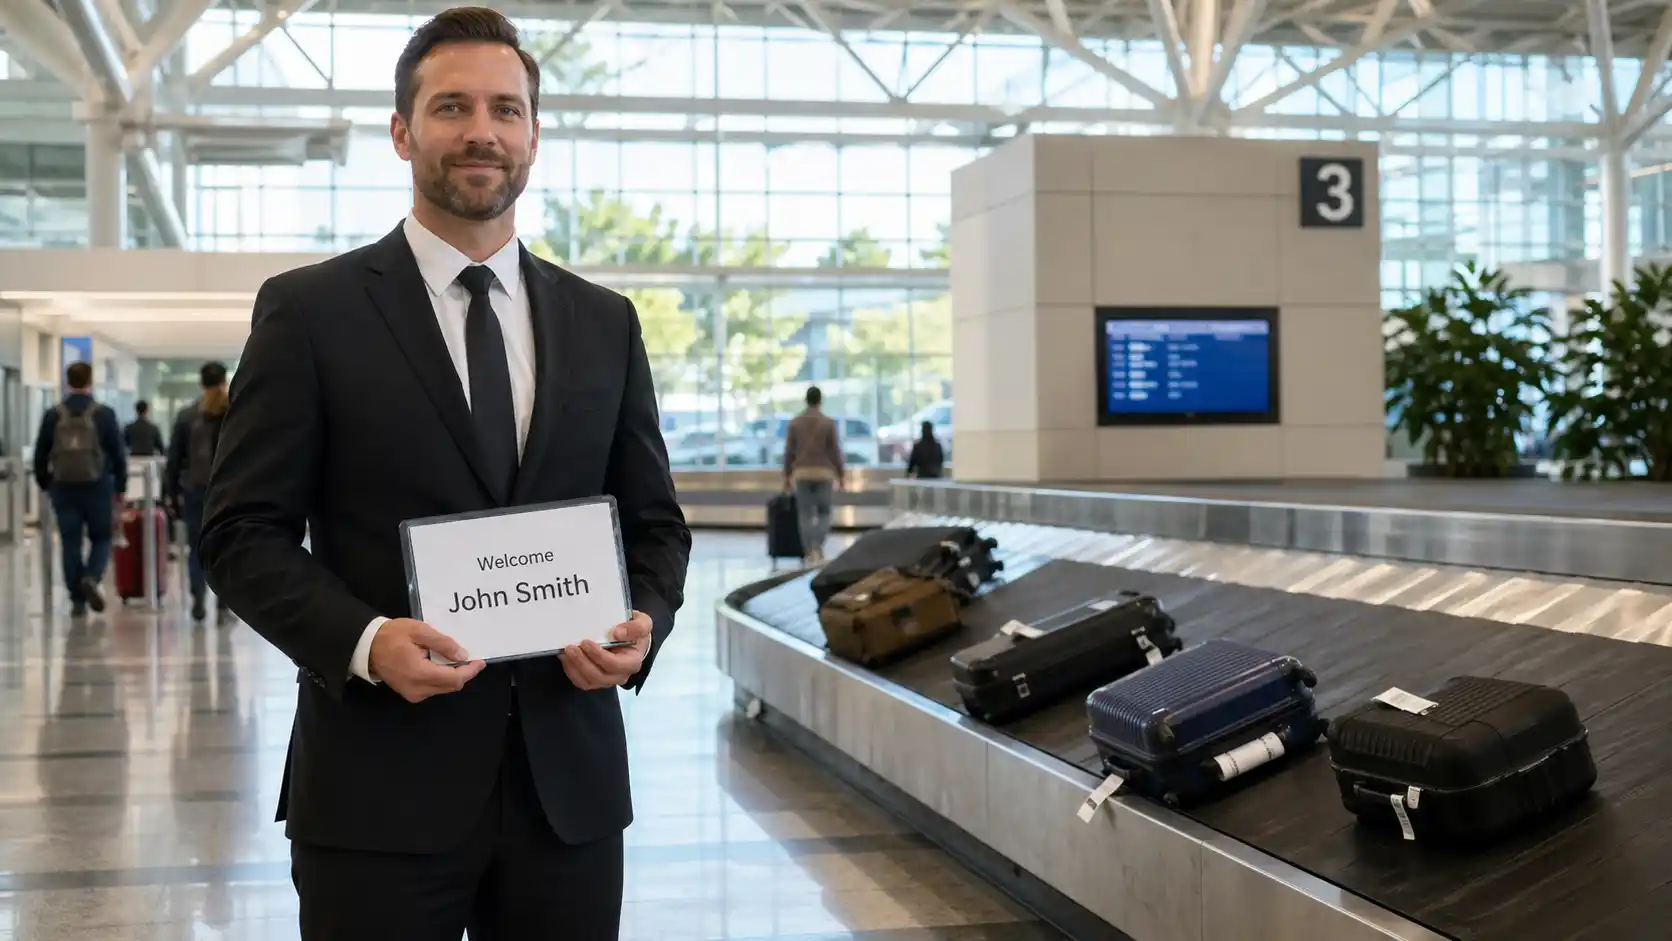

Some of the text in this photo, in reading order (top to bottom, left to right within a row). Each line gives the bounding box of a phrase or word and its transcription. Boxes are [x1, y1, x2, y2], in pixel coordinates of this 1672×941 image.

[1316, 163, 1354, 221] 3
[476, 550, 554, 571] Welcome
[448, 573, 590, 613] John Smith
